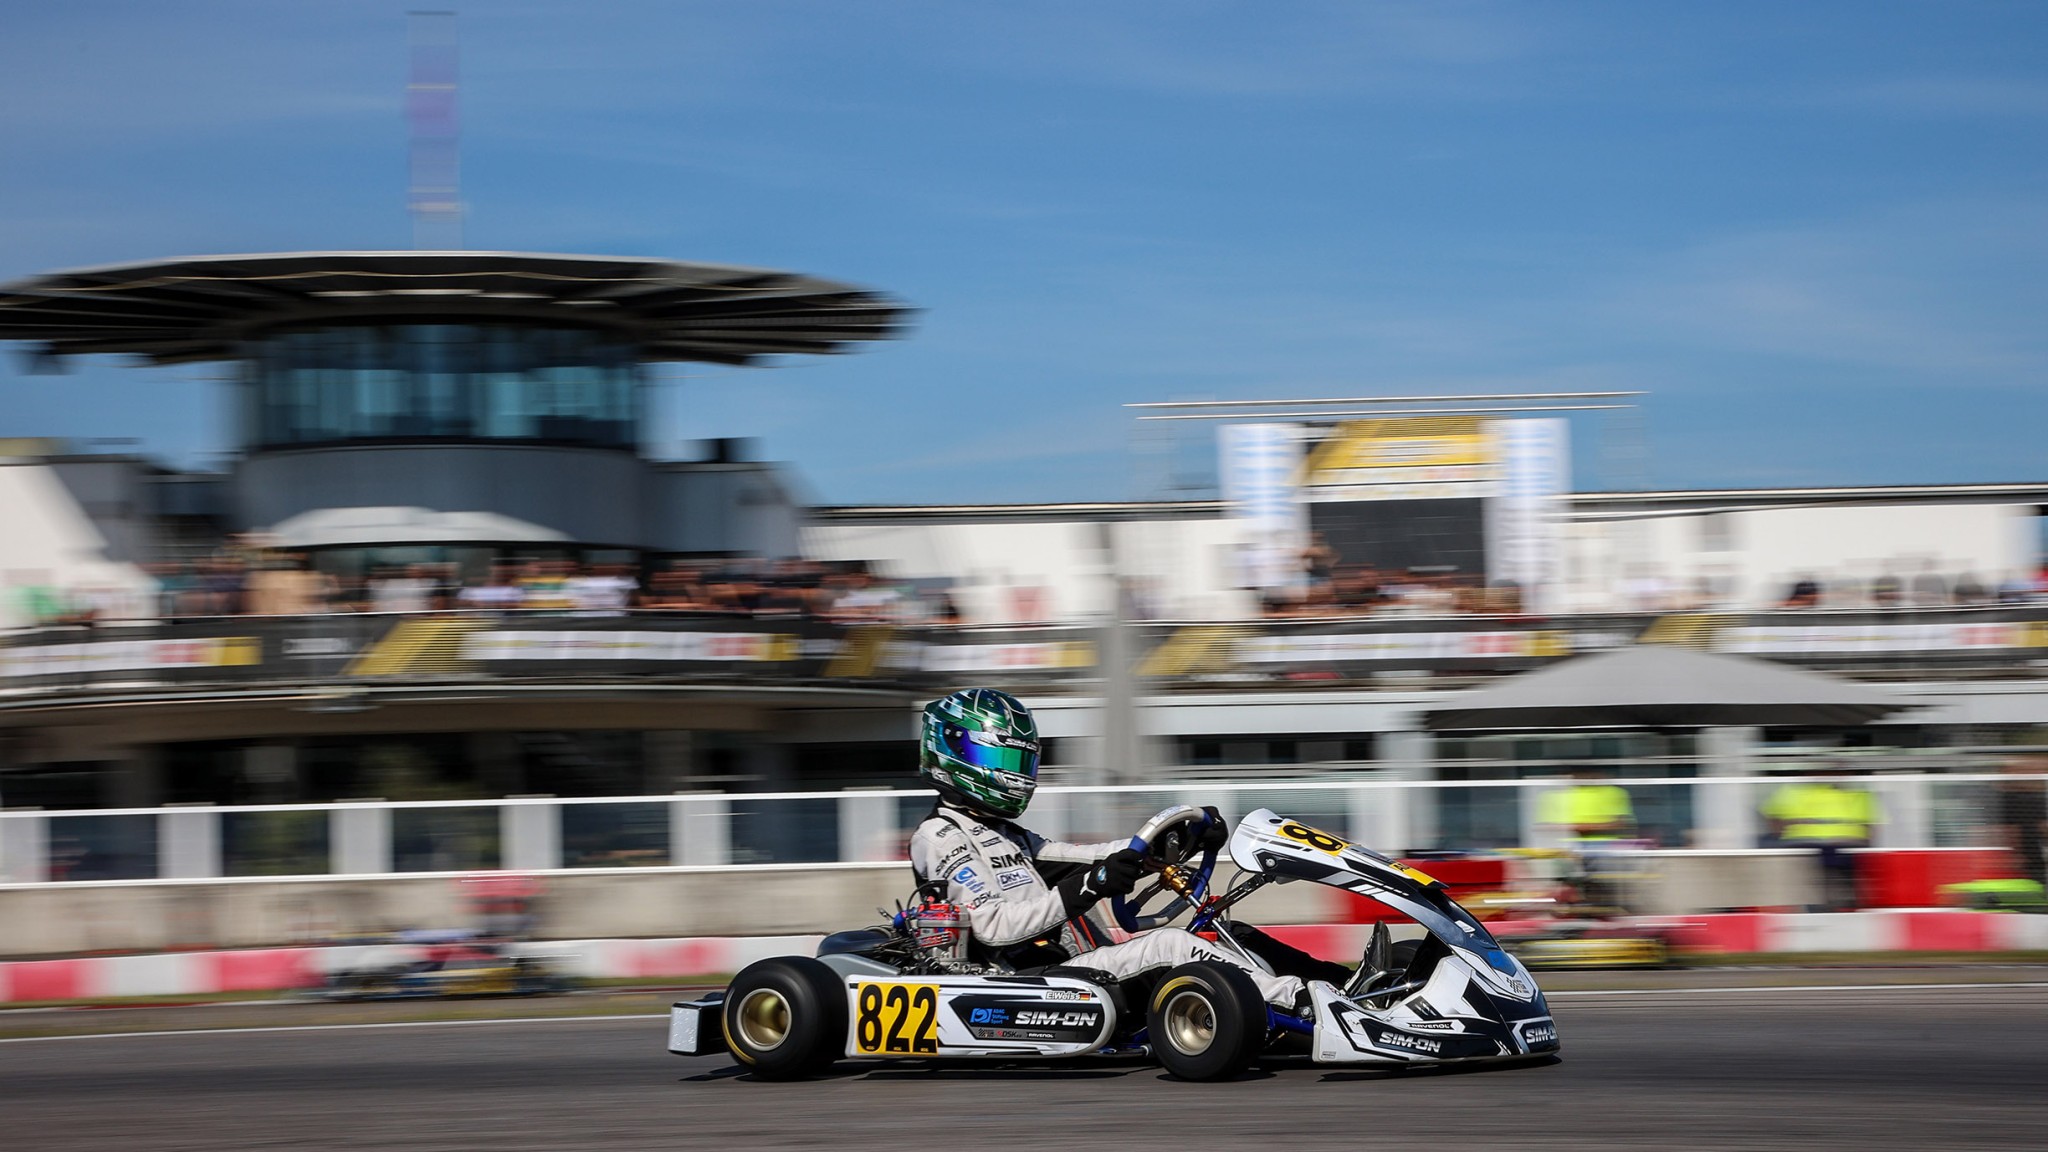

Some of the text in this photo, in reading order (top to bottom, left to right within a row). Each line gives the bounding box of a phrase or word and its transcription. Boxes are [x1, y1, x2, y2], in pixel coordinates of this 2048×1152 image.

[990, 852, 1027, 869] SIM
[857, 984, 937, 1052] 822
[1015, 1010, 1098, 1027] SIM-ON
[1379, 1031, 1442, 1053] SIM-ON
